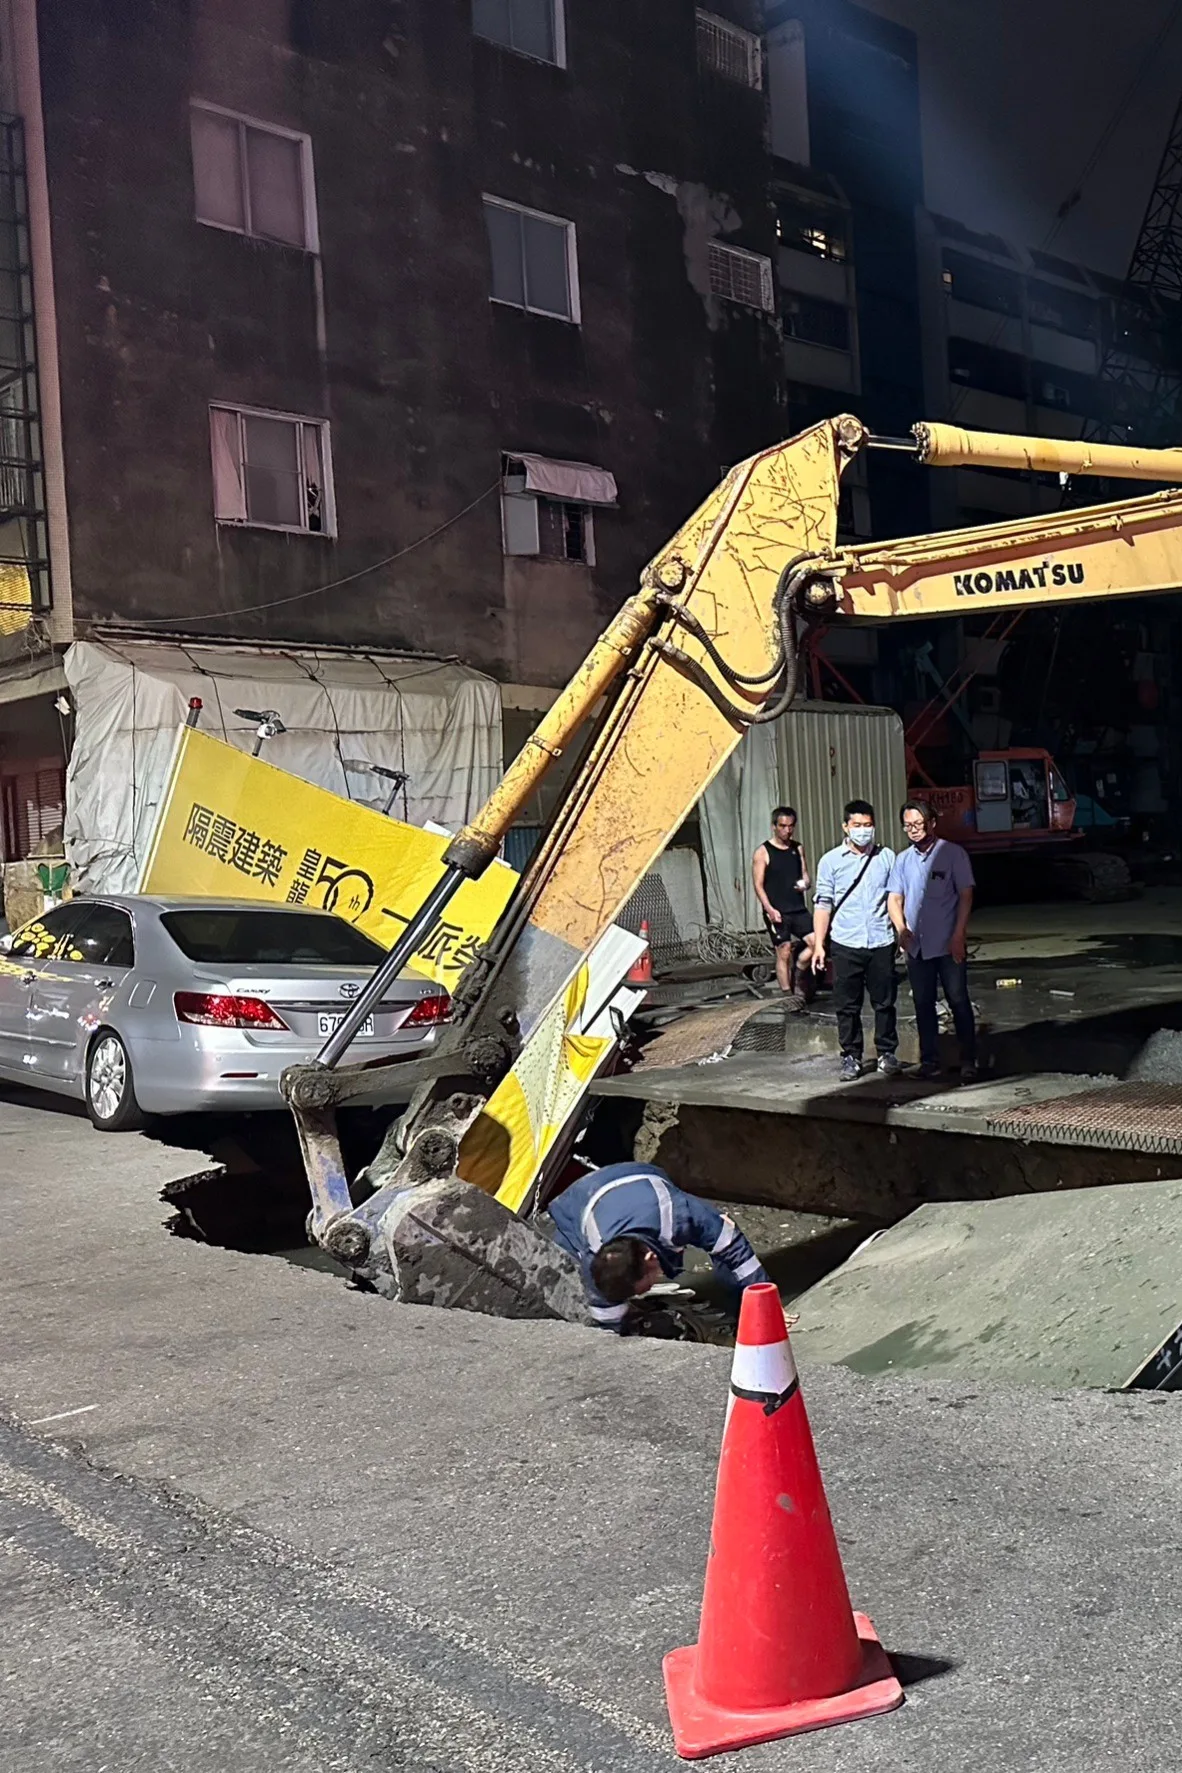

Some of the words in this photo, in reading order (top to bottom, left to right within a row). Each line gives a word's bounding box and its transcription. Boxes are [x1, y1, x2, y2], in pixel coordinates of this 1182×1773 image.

[953, 561, 1085, 596] KOMATSU
[183, 803, 288, 888] 隔震建築
